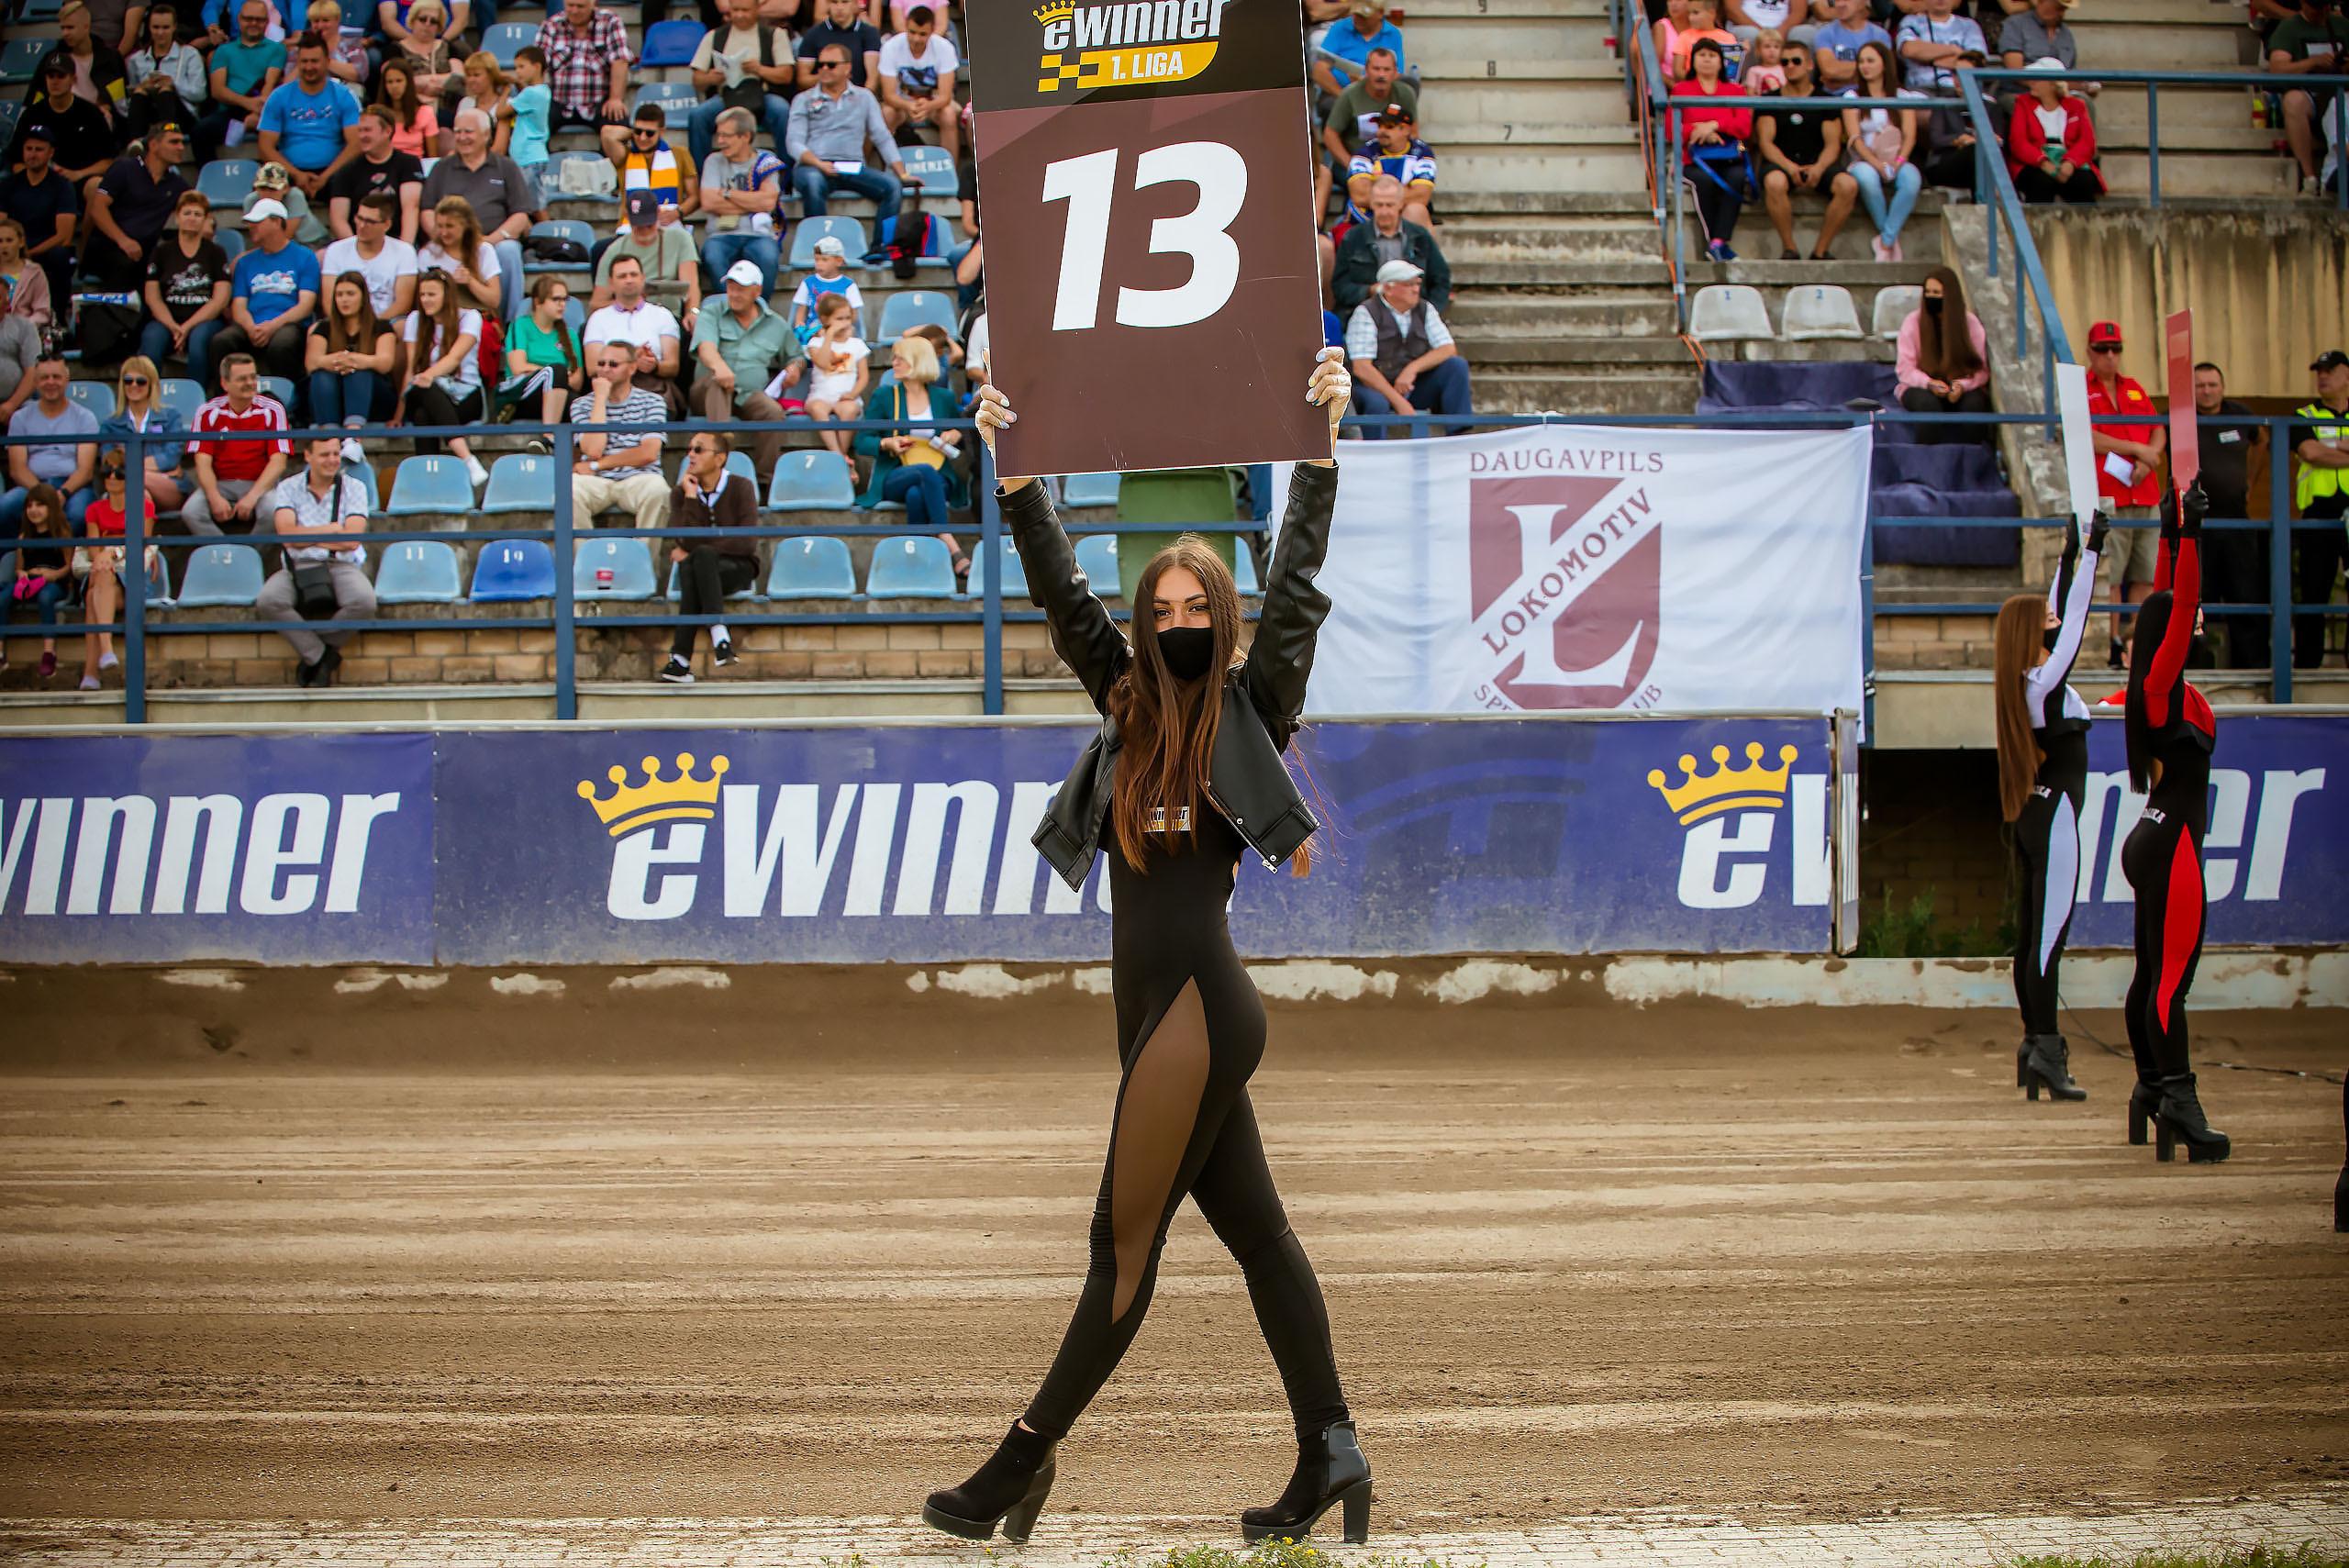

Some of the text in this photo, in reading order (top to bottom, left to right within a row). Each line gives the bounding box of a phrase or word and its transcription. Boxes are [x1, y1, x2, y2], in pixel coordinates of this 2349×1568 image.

[1111, 50, 1184, 80] 1. LIGA
[1504, 125, 1512, 139] 7
[824, 220, 833, 232] 7
[1042, 140, 1248, 331] 13
[805, 455, 815, 468] 7
[1470, 448, 1664, 473] DAUGAVPILS
[804, 540, 814, 554] 7
[905, 540, 916, 554] 6
[1482, 487, 1652, 656] LOKOMOTIV
